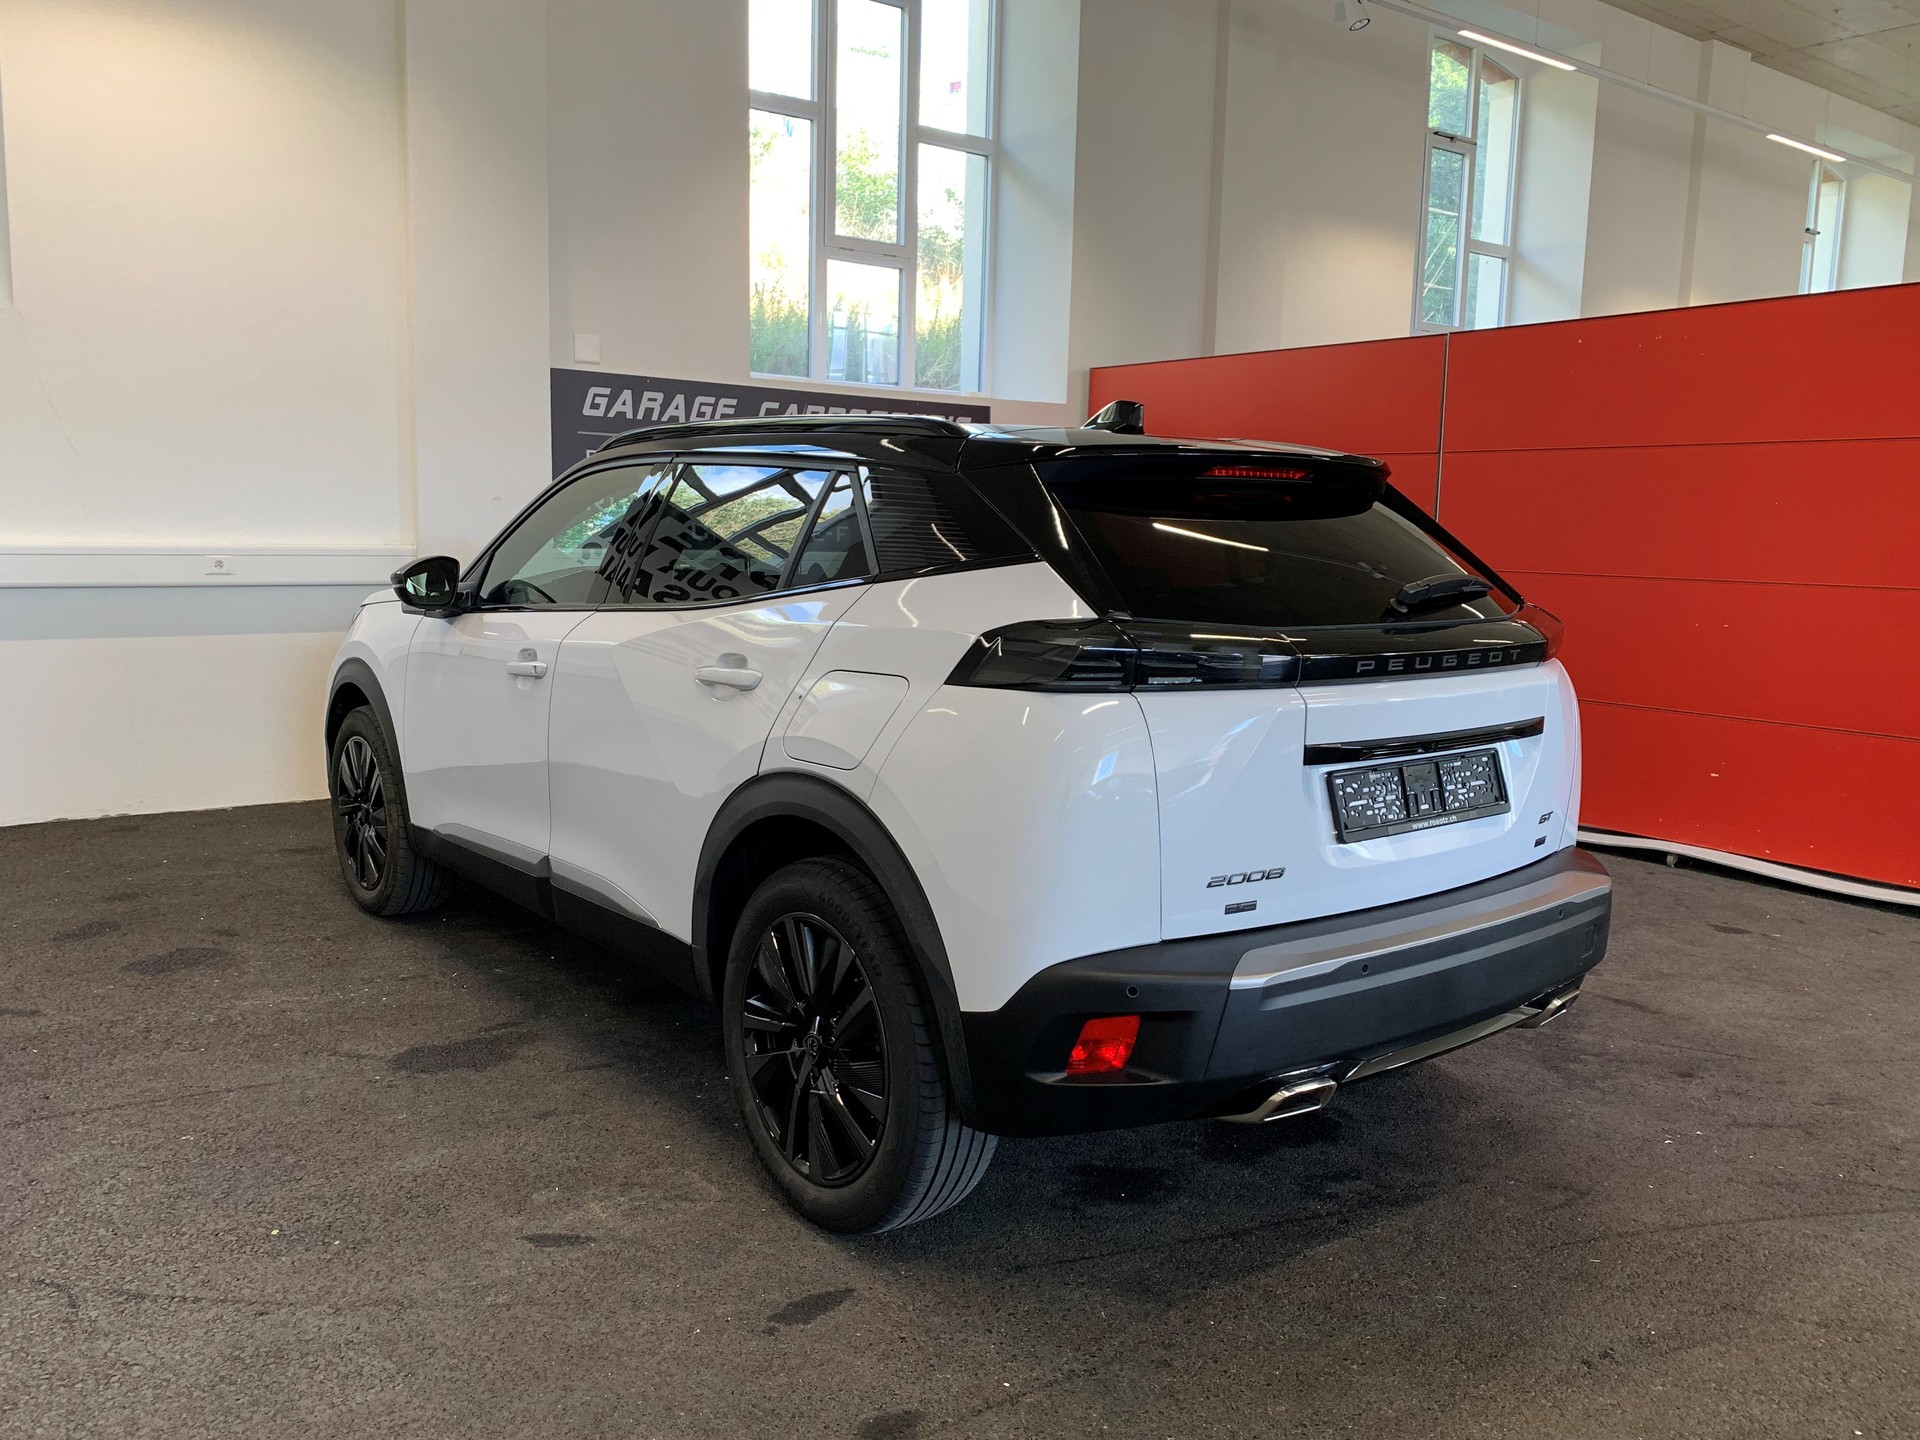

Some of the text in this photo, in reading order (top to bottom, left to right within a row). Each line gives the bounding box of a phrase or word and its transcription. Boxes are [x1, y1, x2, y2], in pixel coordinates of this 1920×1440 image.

[582, 385, 739, 422] GARAGE
[1355, 649, 1522, 674] PEUGEOT
[1206, 866, 1286, 888] 2008
